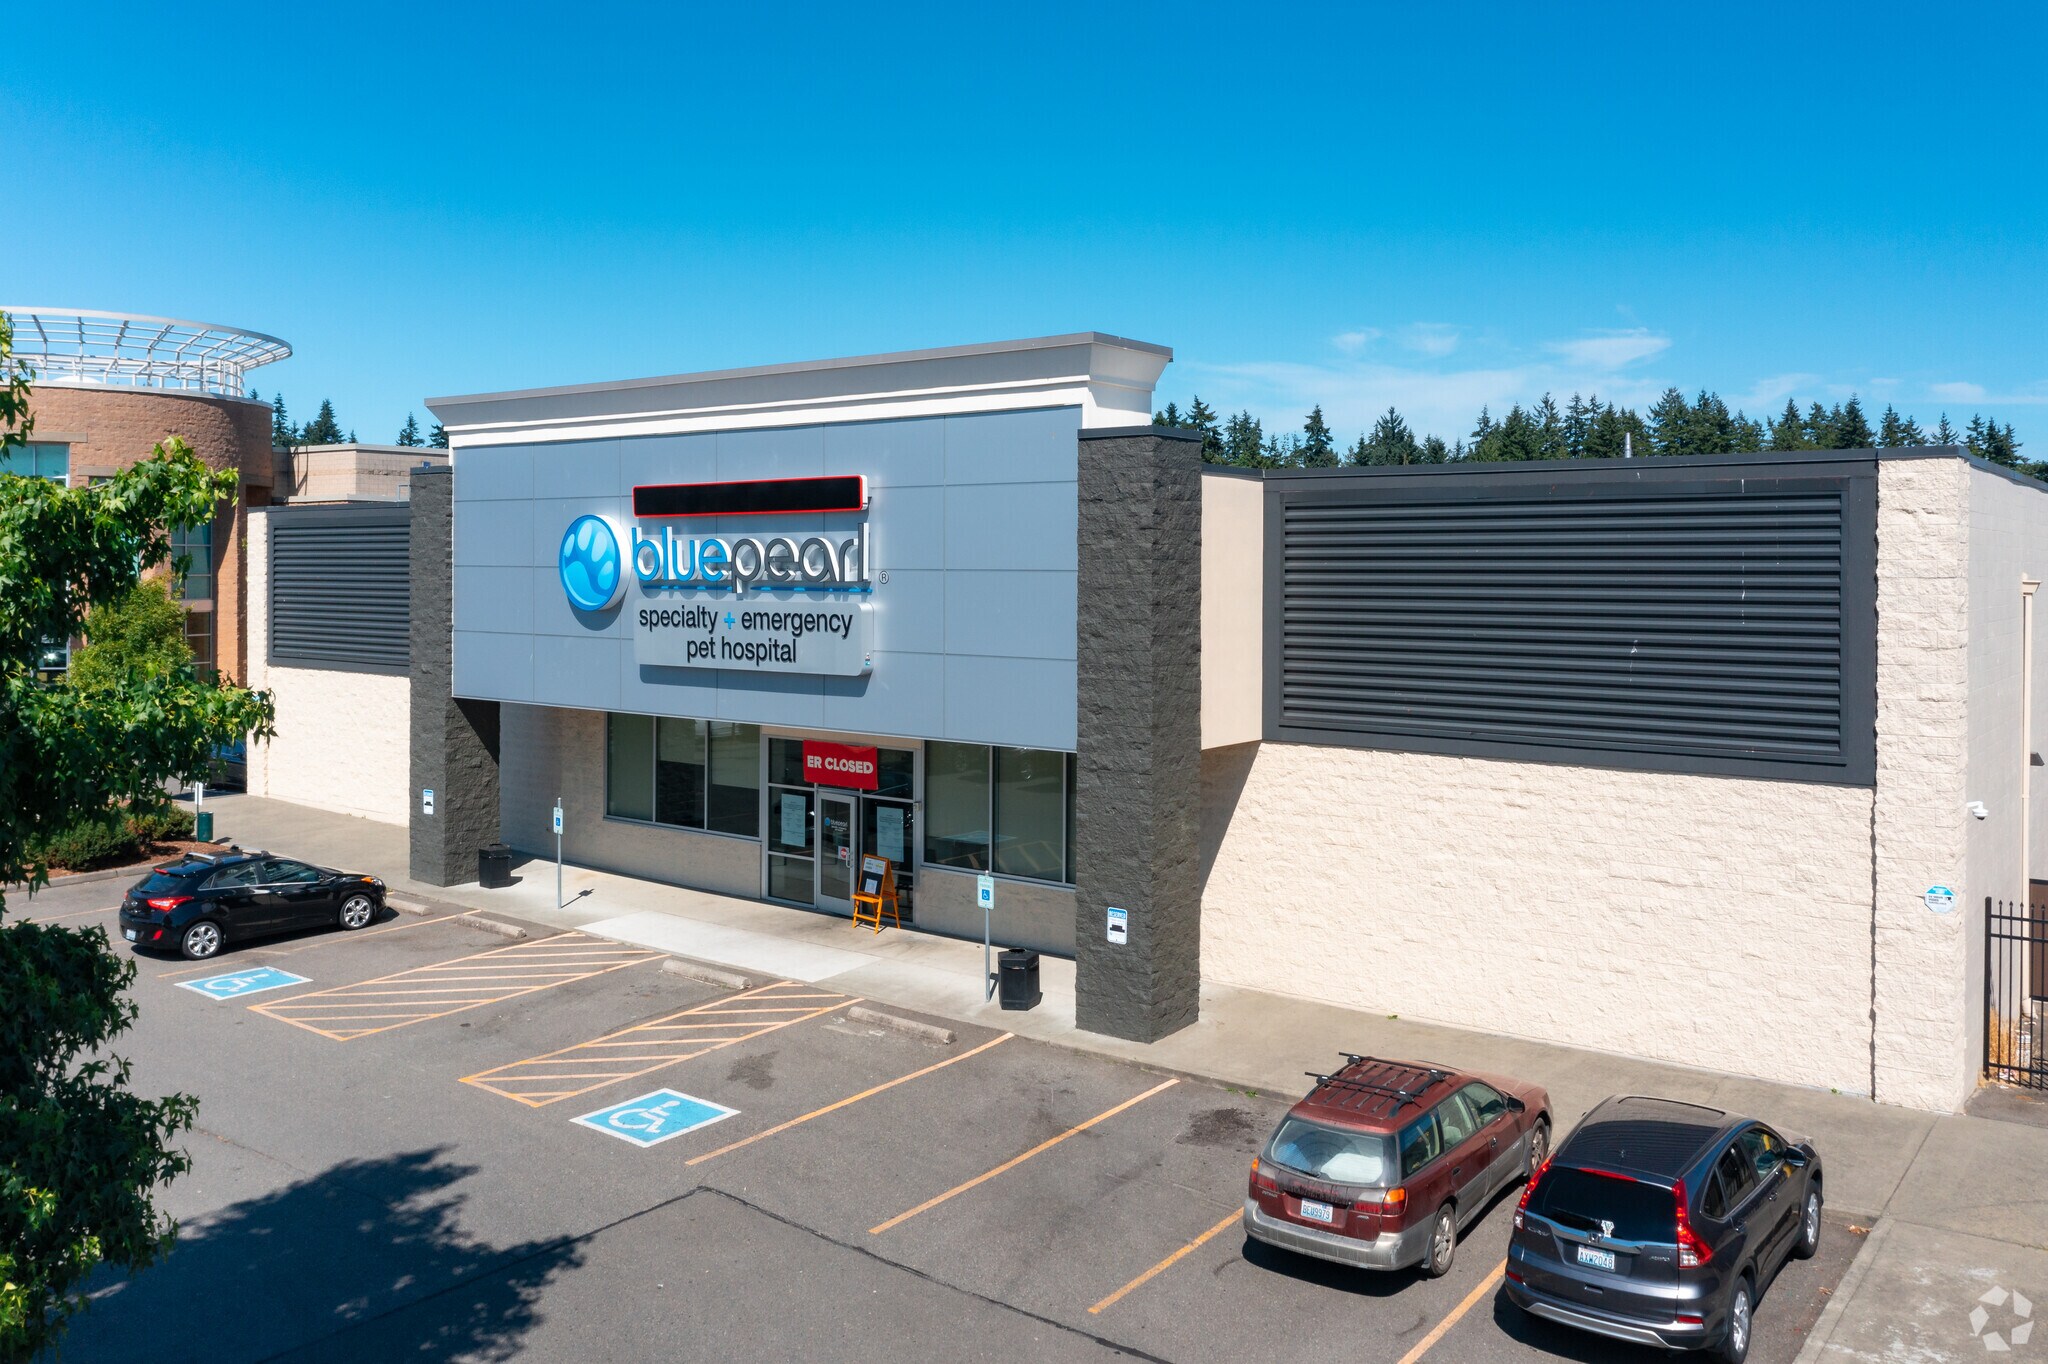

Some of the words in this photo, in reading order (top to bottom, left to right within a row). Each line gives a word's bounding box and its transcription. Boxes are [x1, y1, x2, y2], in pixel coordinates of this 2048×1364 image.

[631, 522, 869, 594] bluepearl
[639, 605, 718, 634] specialty
[741, 610, 853, 640] emergency
[687, 636, 716, 664] pet
[721, 636, 797, 666] hospital
[807, 755, 822, 769] ER
[824, 757, 873, 774] CLOSED
